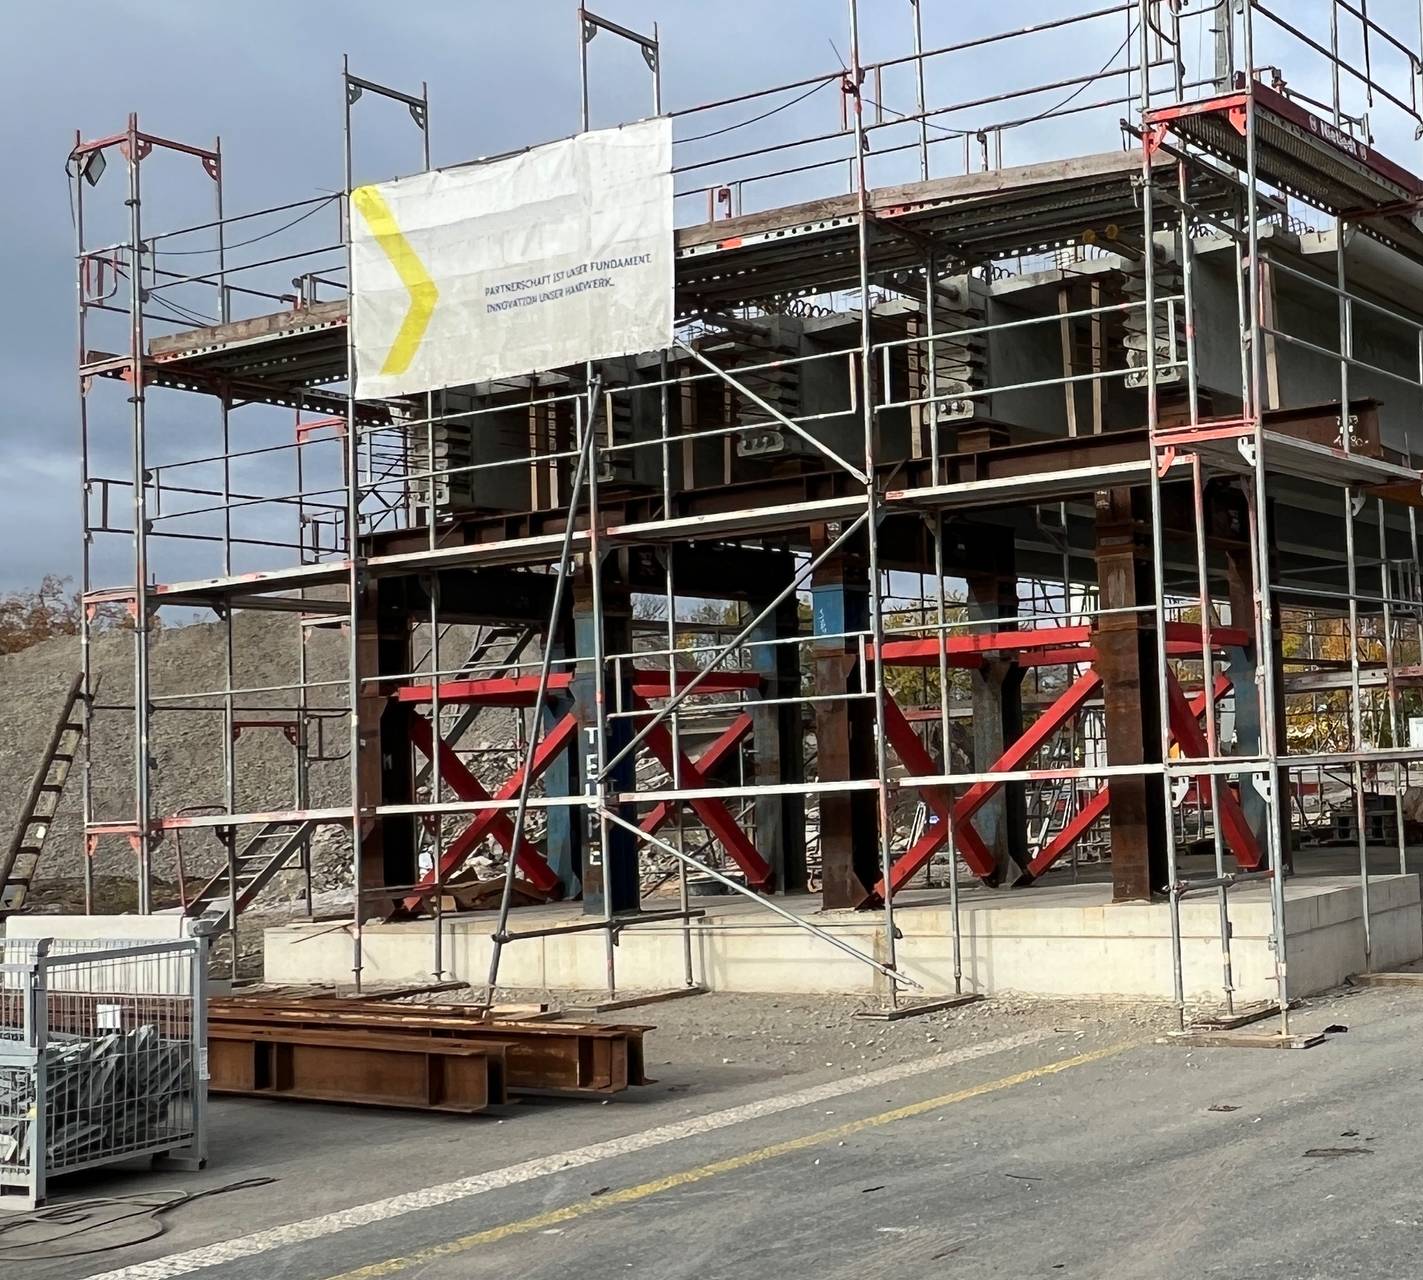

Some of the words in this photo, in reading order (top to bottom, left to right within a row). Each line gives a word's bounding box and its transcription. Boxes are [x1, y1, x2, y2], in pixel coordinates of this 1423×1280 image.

[485, 274, 551, 296] PARTNERSCHAFT
[553, 270, 565, 283] IST
[566, 263, 588, 278] UNSER
[486, 295, 538, 313] INNOVATION
[539, 288, 564, 303] UNSER
